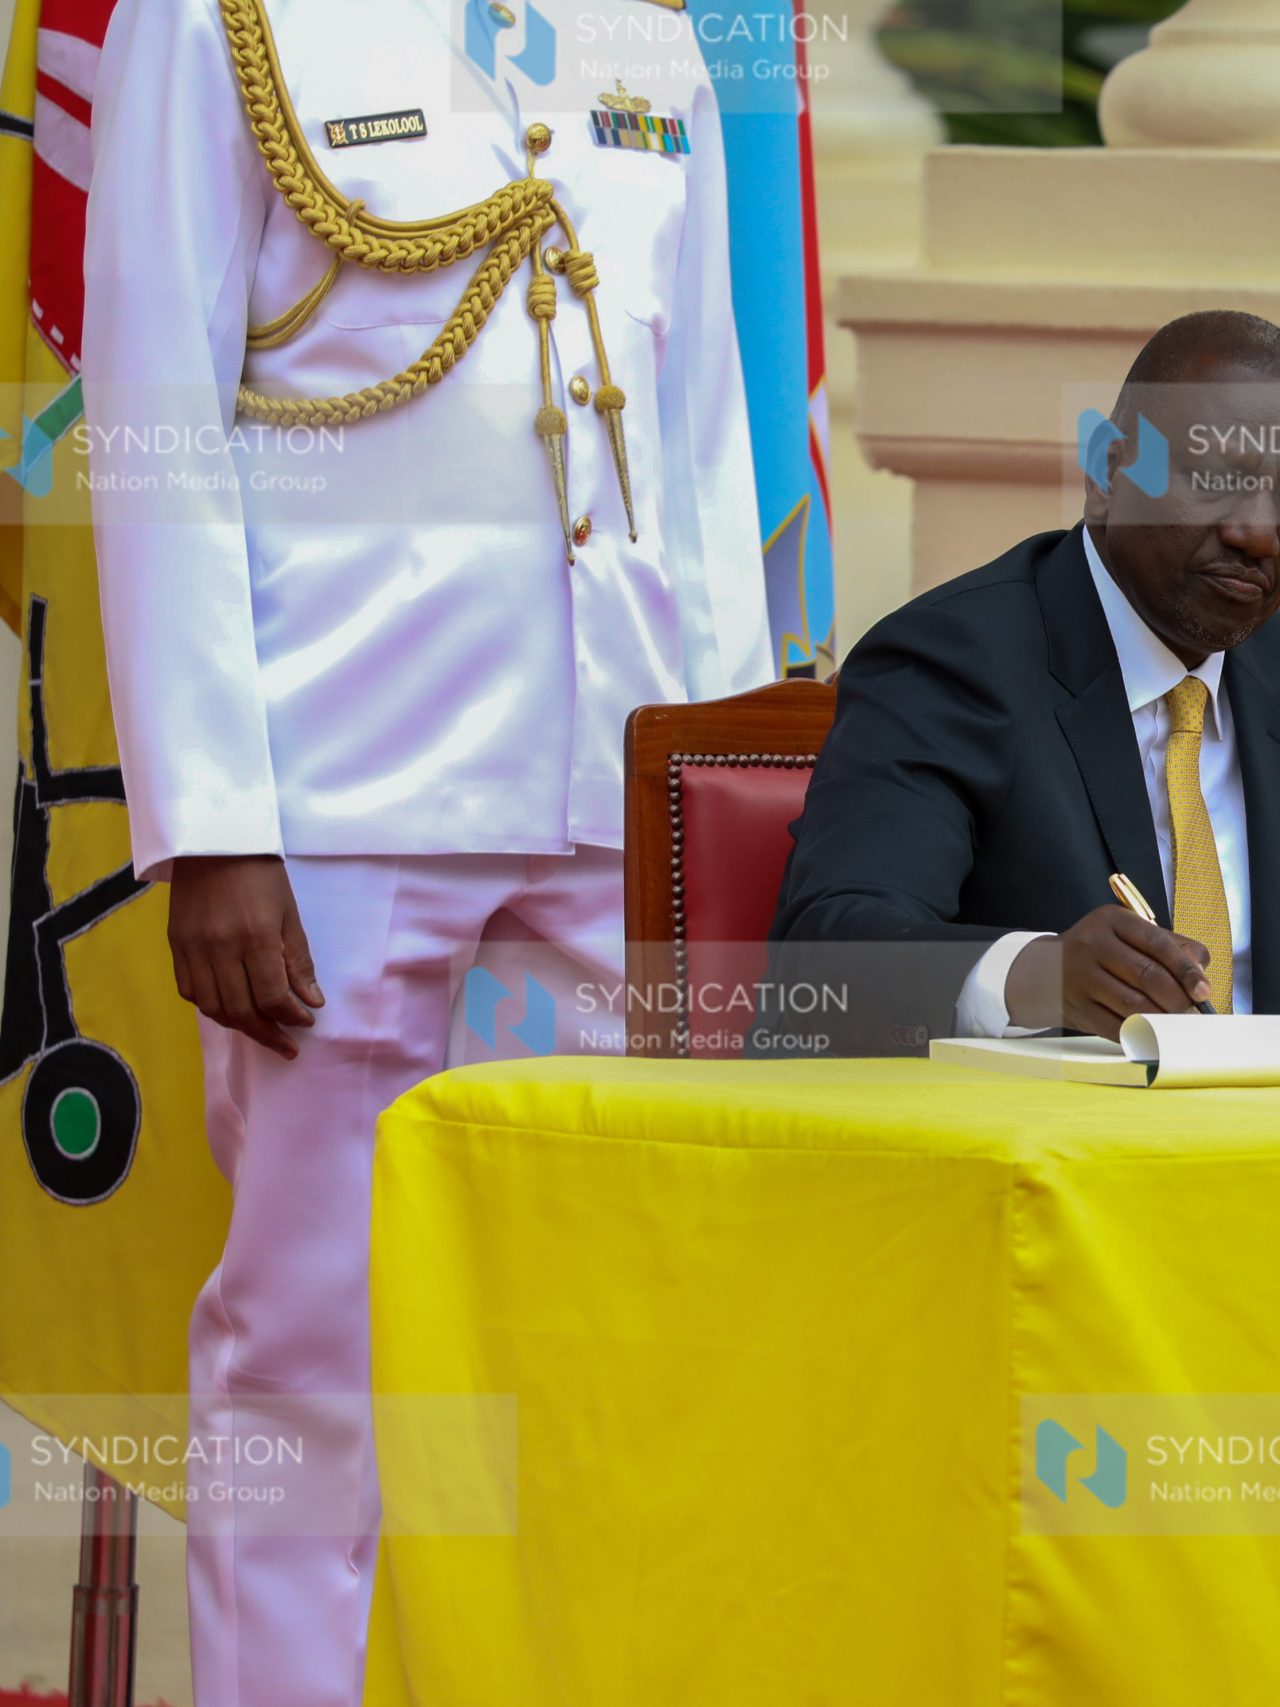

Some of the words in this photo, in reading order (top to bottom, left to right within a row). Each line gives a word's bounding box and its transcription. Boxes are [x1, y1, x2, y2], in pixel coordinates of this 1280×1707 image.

[349, 124, 358, 139] T
[360, 123, 368, 138] S
[368, 115, 423, 137] LEKOLOOL
